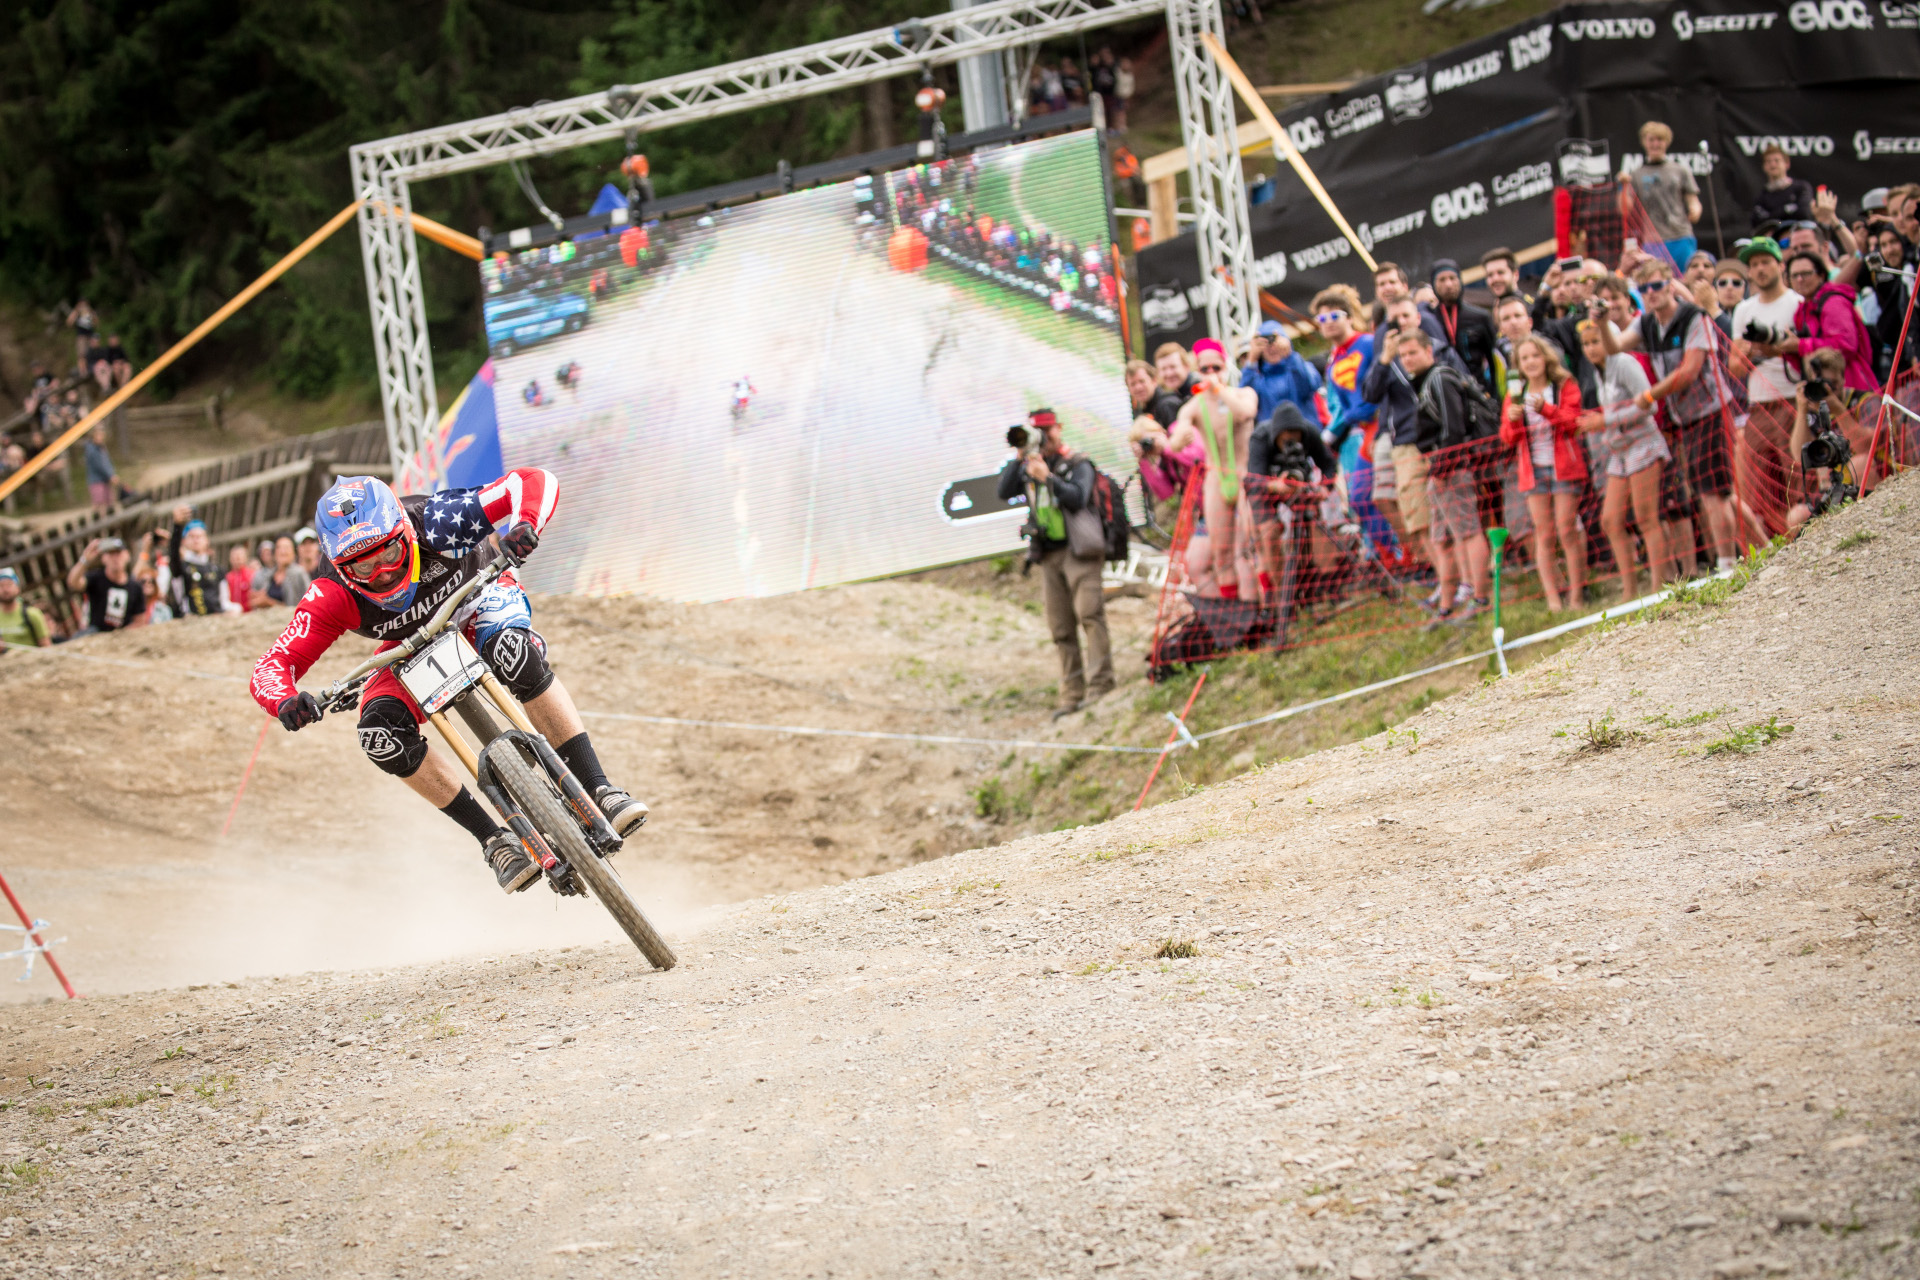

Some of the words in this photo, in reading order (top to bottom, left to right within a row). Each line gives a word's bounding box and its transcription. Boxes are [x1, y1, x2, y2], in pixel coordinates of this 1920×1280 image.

[1559, 18, 1656, 41] VOLVO
[1694, 12, 1778, 33] SCOTT
[1432, 52, 1502, 95] MAXXIS
[1324, 93, 1382, 128] GoPro
[1735, 135, 1835, 157] VOLVO
[1491, 161, 1552, 196] GoPro
[1621, 152, 1713, 177] MXXIS
[1371, 209, 1427, 244] SCOTT
[1291, 236, 1351, 272] VOLVO
[336, 532, 357, 554] Red
[356, 526, 382, 544] Bull
[372, 569, 463, 639] SPECIALIZED
[426, 655, 448, 679] 1
